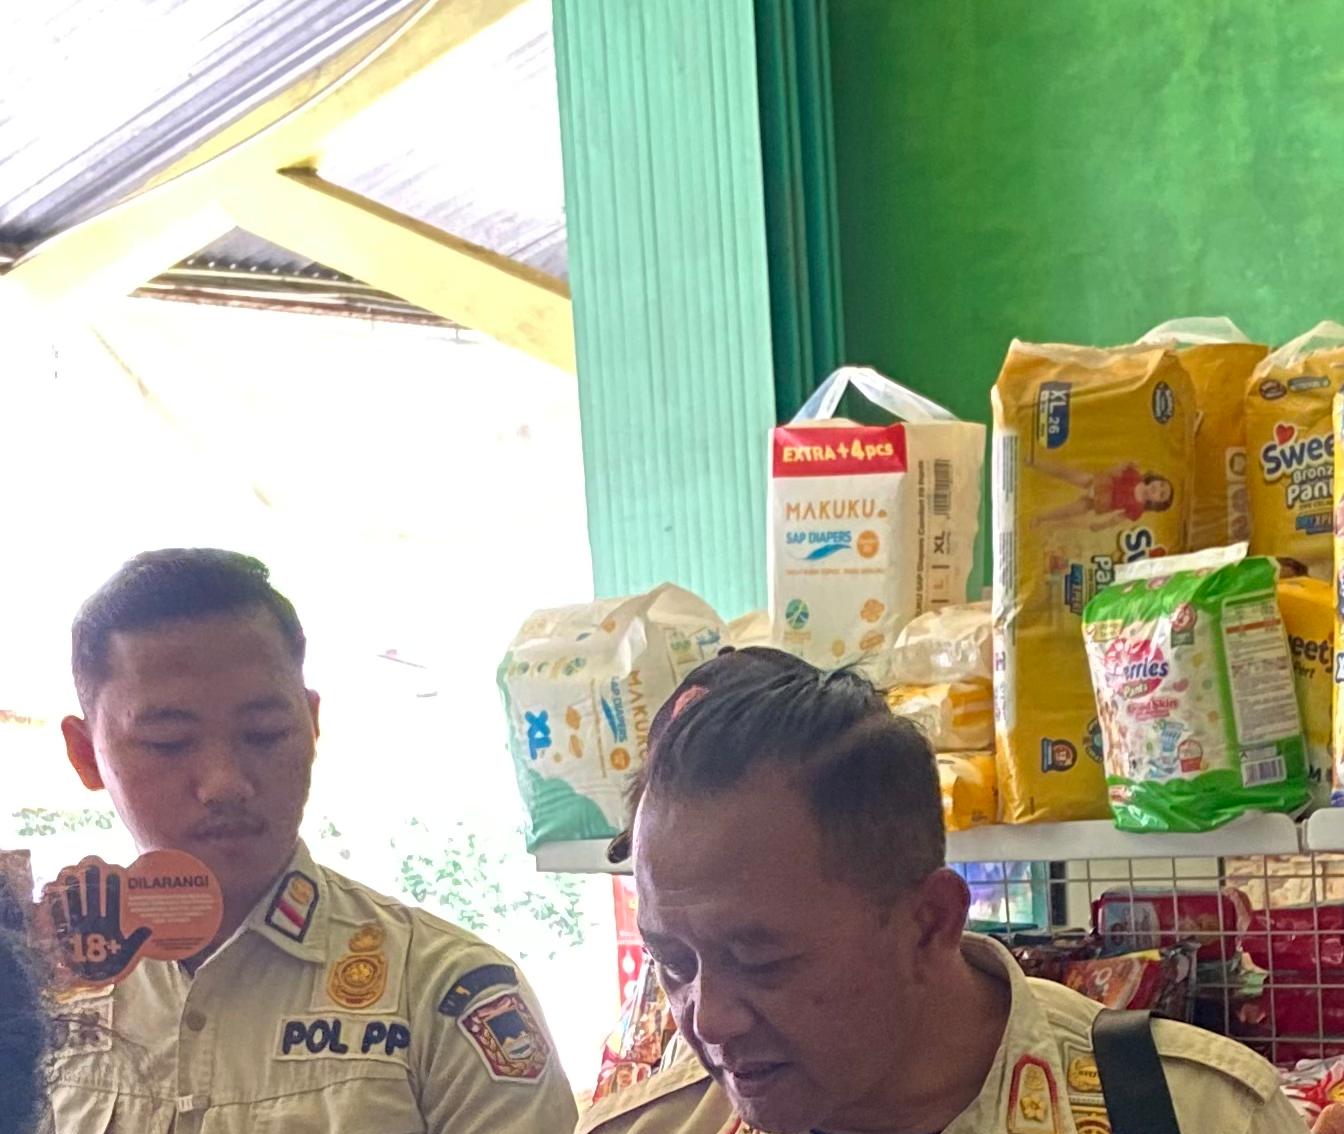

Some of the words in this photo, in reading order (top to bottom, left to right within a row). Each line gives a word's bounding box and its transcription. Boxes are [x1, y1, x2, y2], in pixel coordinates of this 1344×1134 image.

[1262, 432, 1335, 476] Swee
[785, 499, 876, 521] MAKUKU
[785, 530, 806, 545] SAP
[808, 529, 853, 545] DIAPERS
[525, 709, 553, 760] XL
[127, 875, 209, 890] DILARANG!
[67, 933, 123, 964] 18+
[282, 1019, 350, 1056] POL
[360, 1017, 411, 1058] PP
